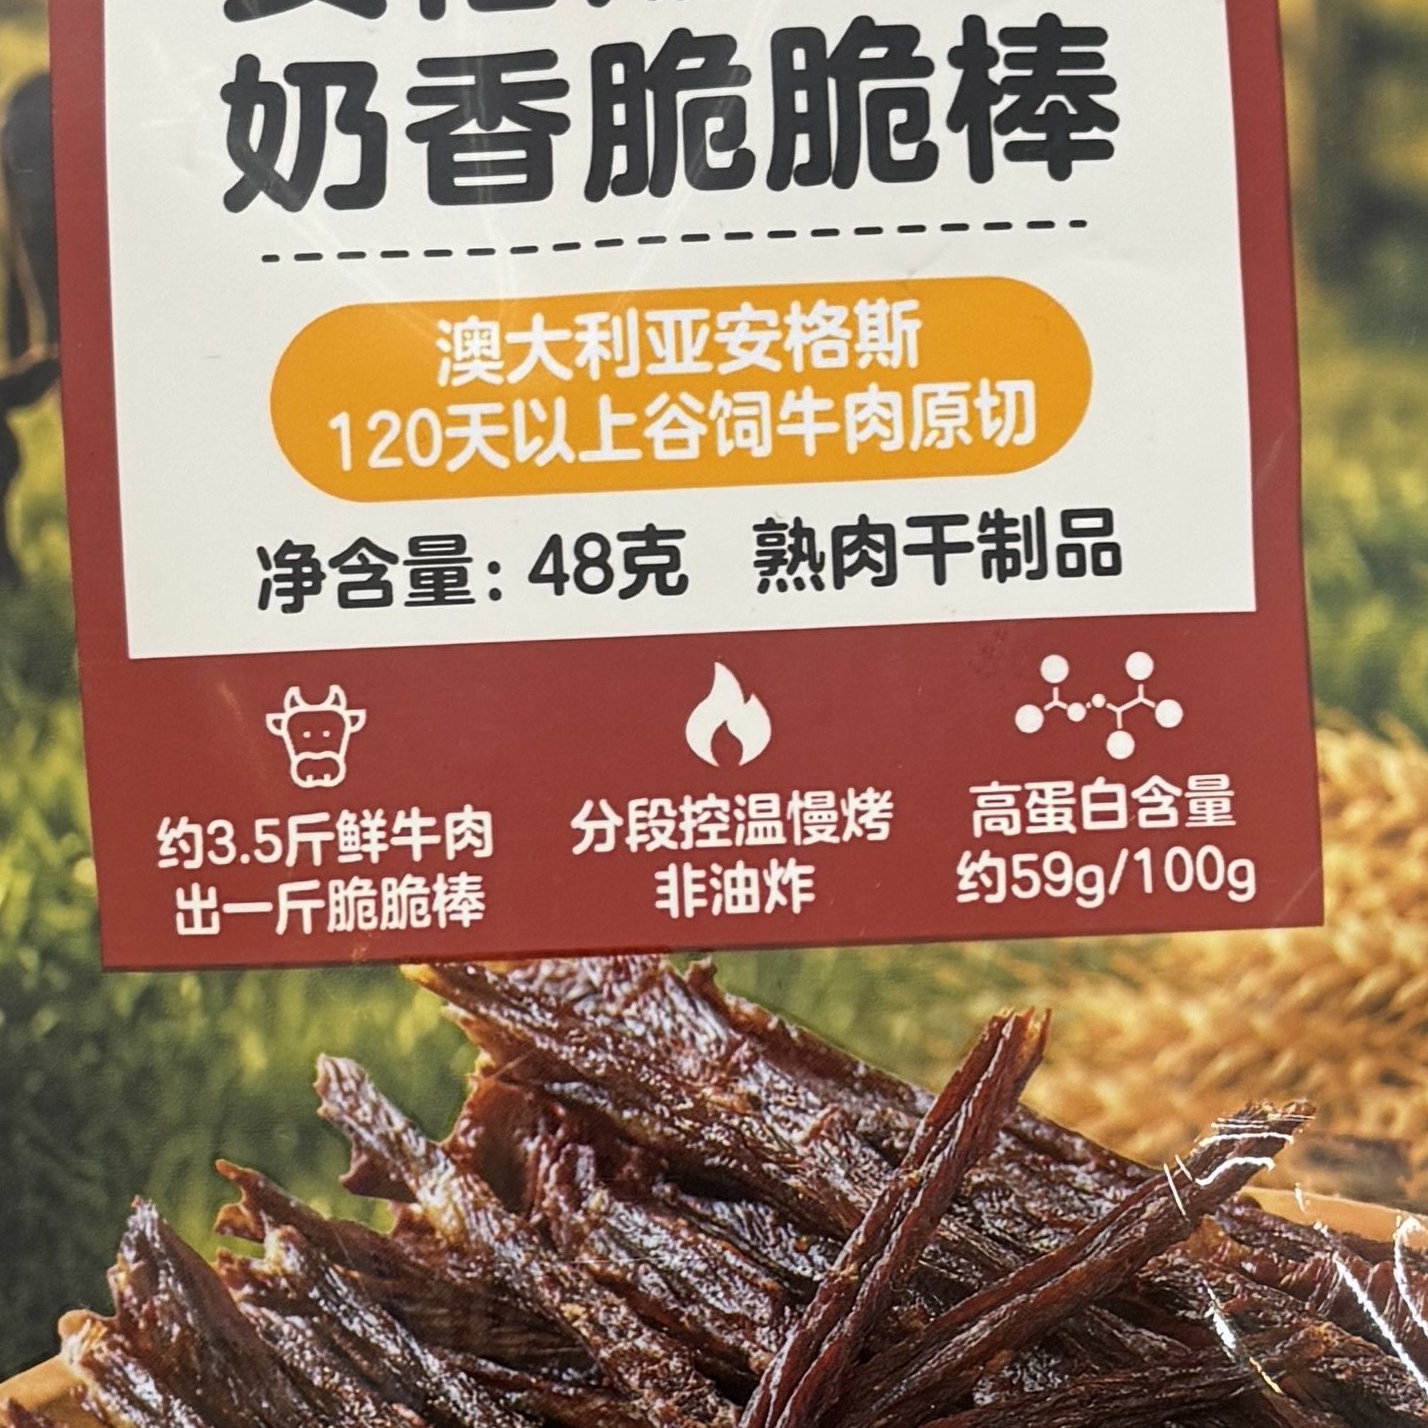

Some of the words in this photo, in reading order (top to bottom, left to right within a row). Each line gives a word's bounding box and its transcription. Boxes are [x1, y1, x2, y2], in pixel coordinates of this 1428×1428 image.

[219, 13, 1121, 214] 奶香脆脆棒
[435, 299, 921, 388] 澳大利亚安格斯
[327, 378, 1036, 474] 120天以上谷饲牛肉原切
[256, 523, 690, 615] 净含量：48克
[752, 506, 1123, 594] 熟肉干制品
[156, 804, 494, 871] 约3.5斤鲜牛肉
[570, 787, 894, 855] 分段控温慢烤
[969, 775, 1237, 838] 高蛋白含量
[174, 872, 486, 938] 出一斤脆脆棒
[654, 860, 816, 921] 非油炸
[956, 847, 1258, 912] 约59g/100g
